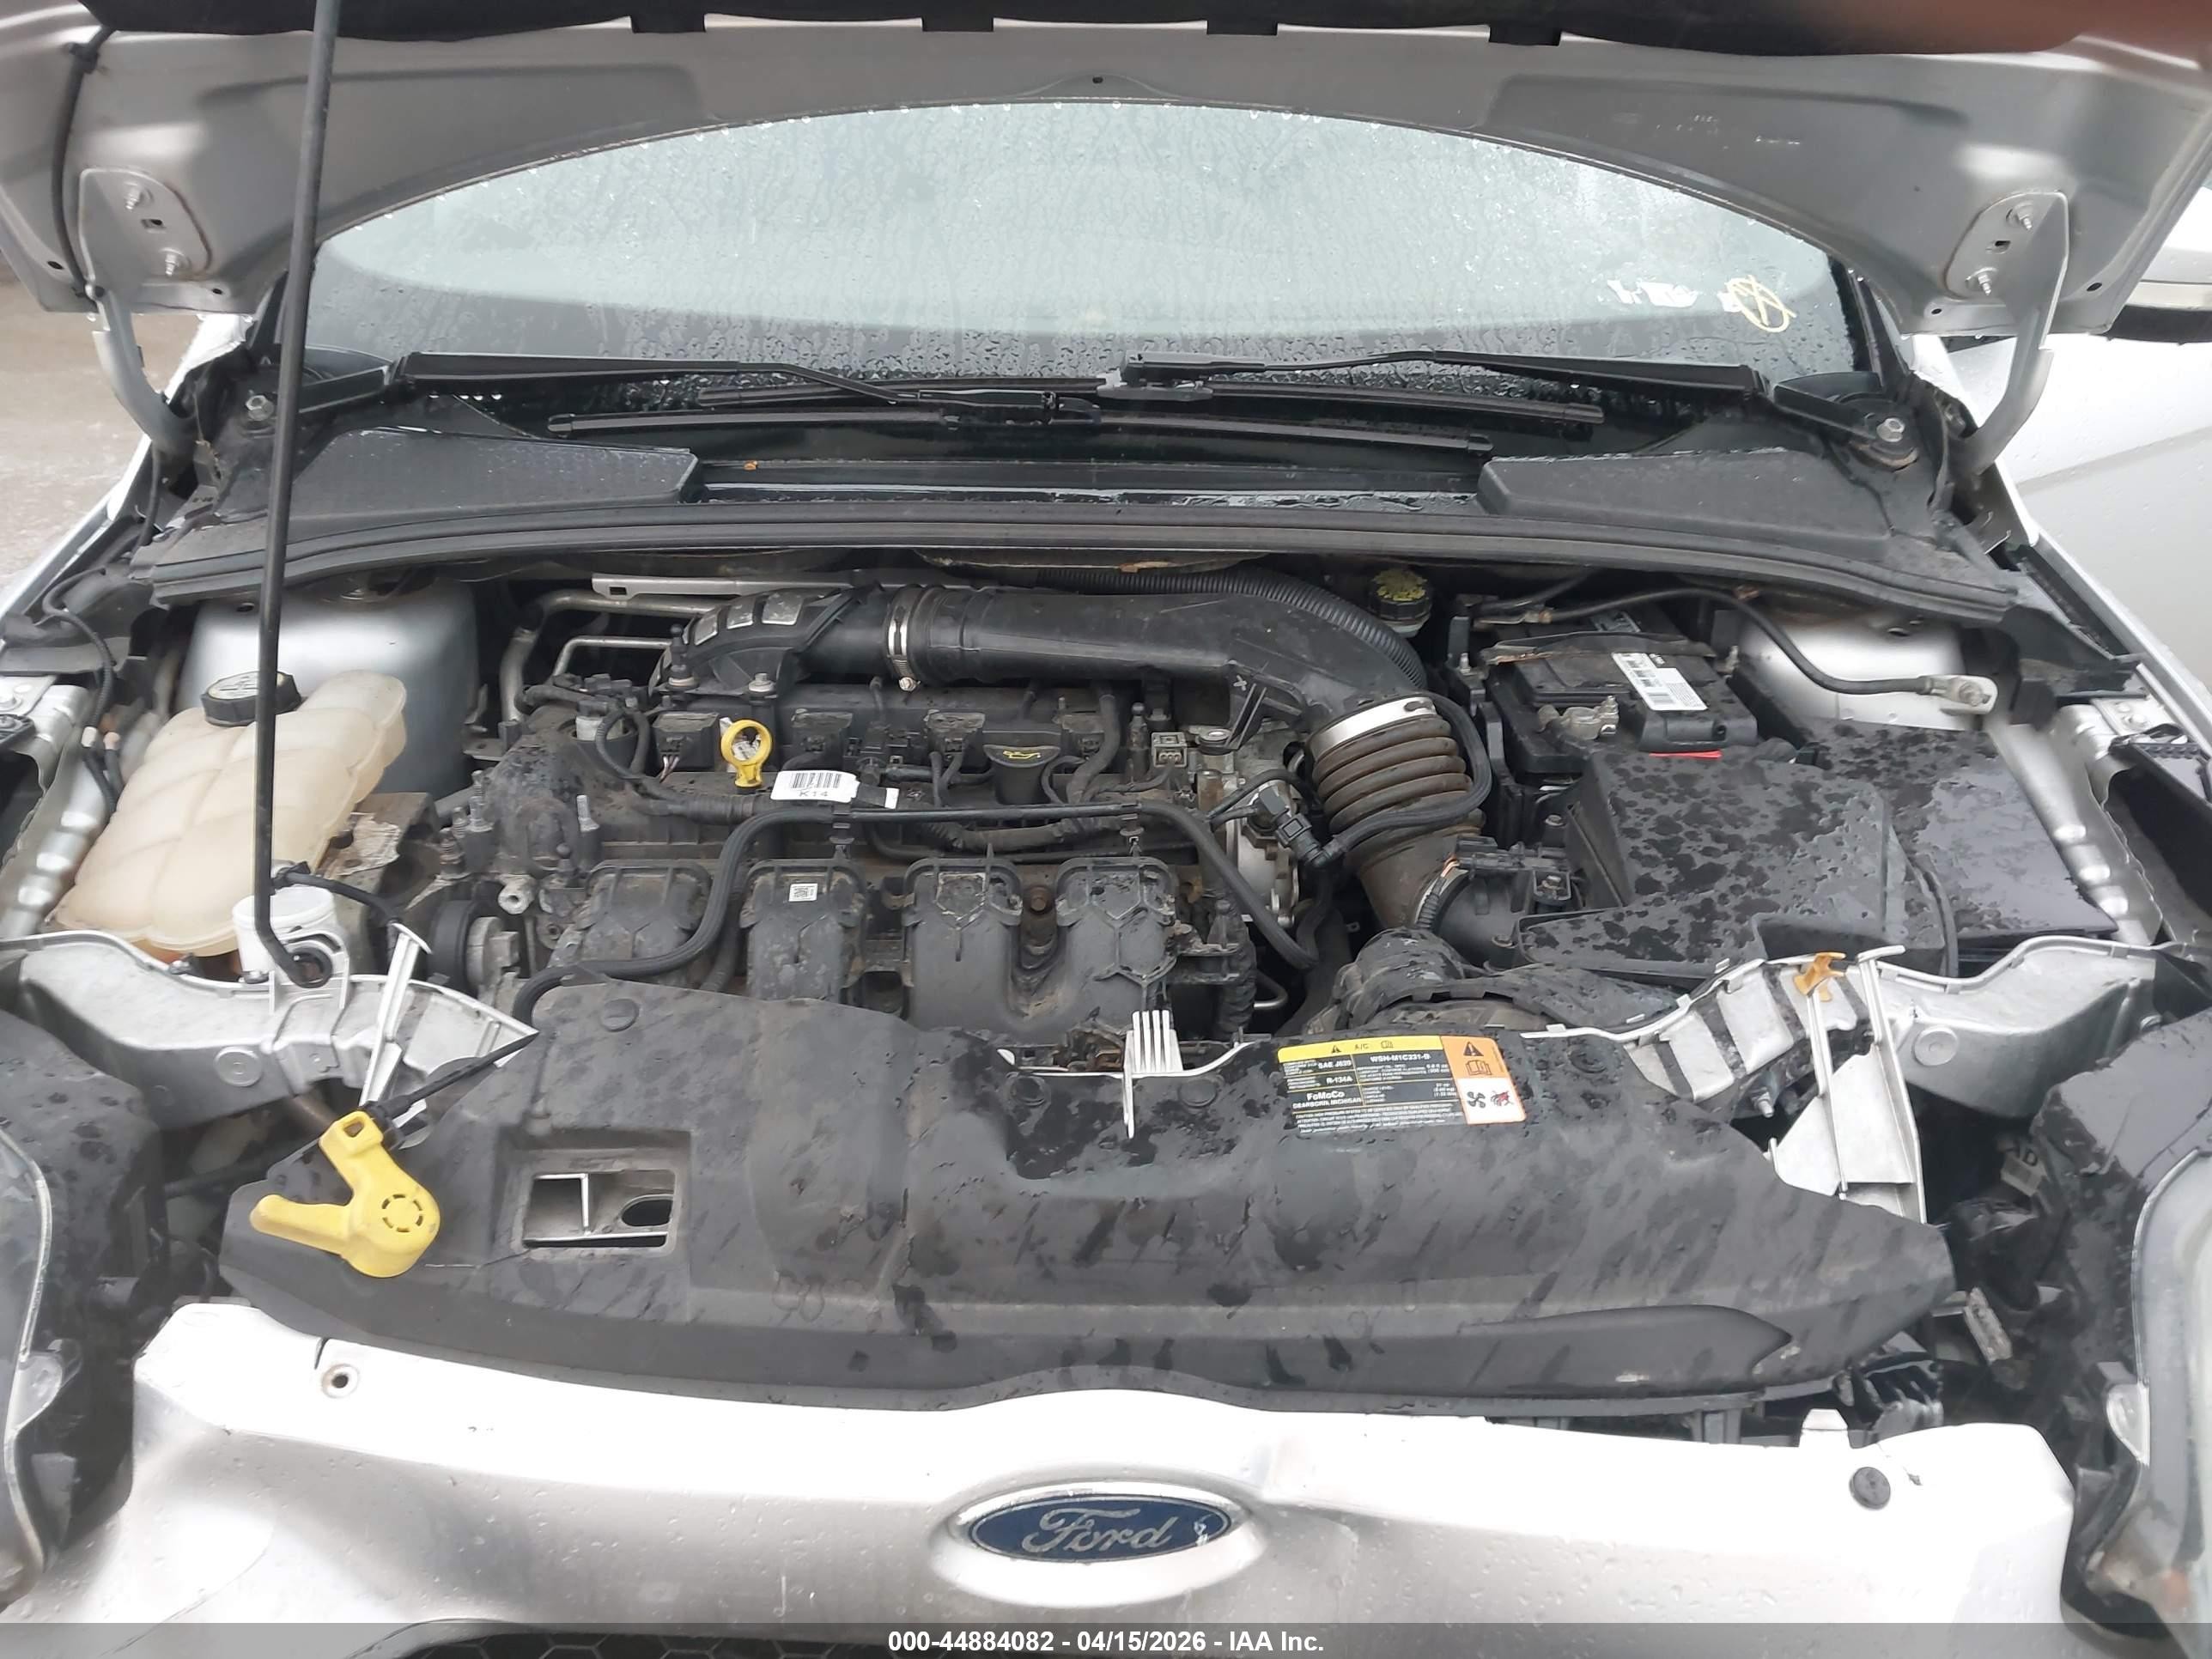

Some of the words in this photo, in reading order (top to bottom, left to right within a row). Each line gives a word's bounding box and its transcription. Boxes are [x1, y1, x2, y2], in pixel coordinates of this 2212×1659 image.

[1326, 1075, 1353, 1085] R-134A
[1306, 1090, 1346, 1101] FoMoCo
[1022, 1508, 1177, 1553] Ford
